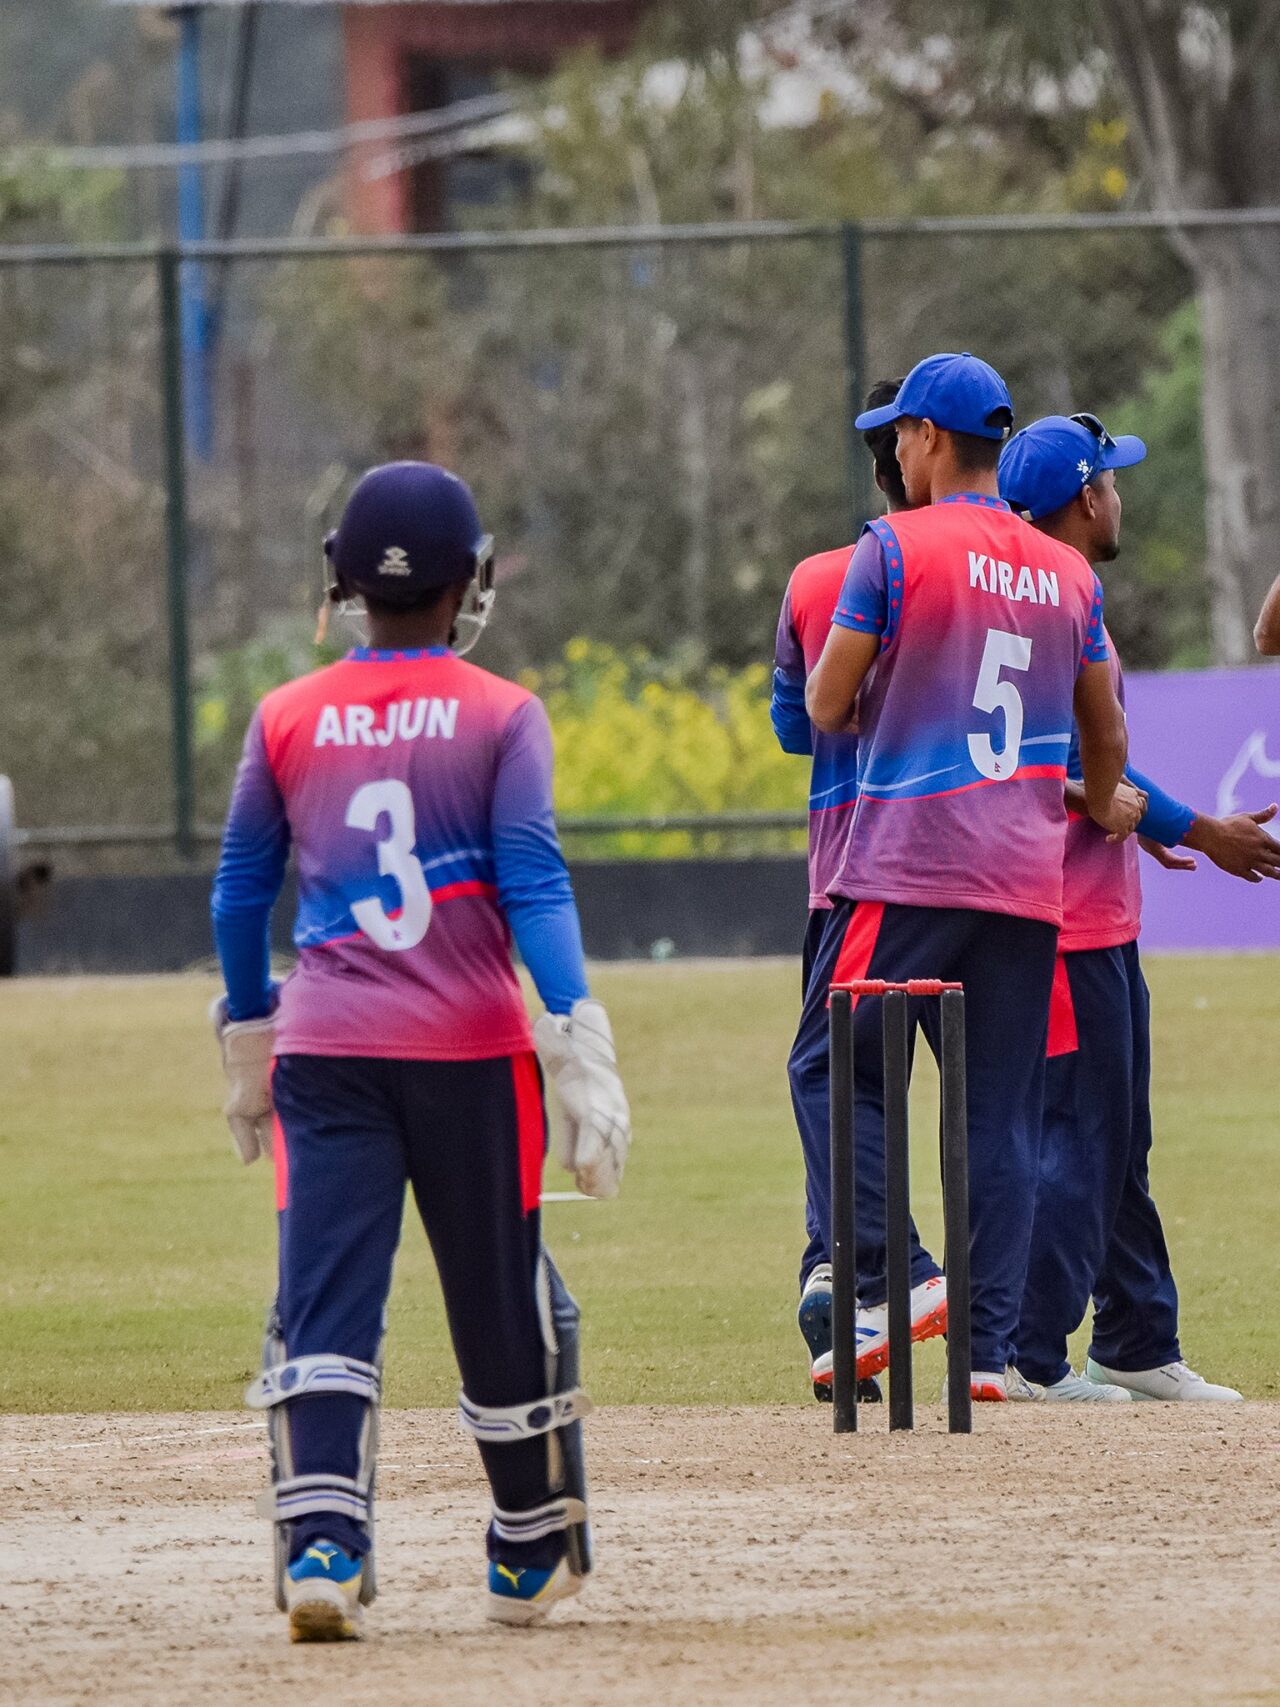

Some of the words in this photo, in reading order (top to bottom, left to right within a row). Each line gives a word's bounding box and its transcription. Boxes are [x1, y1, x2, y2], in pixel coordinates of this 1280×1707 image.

[968, 551, 1060, 607] KIRAN
[314, 697, 460, 748] ARJUN
[967, 628, 1033, 782] 5
[345, 778, 433, 951] 3
